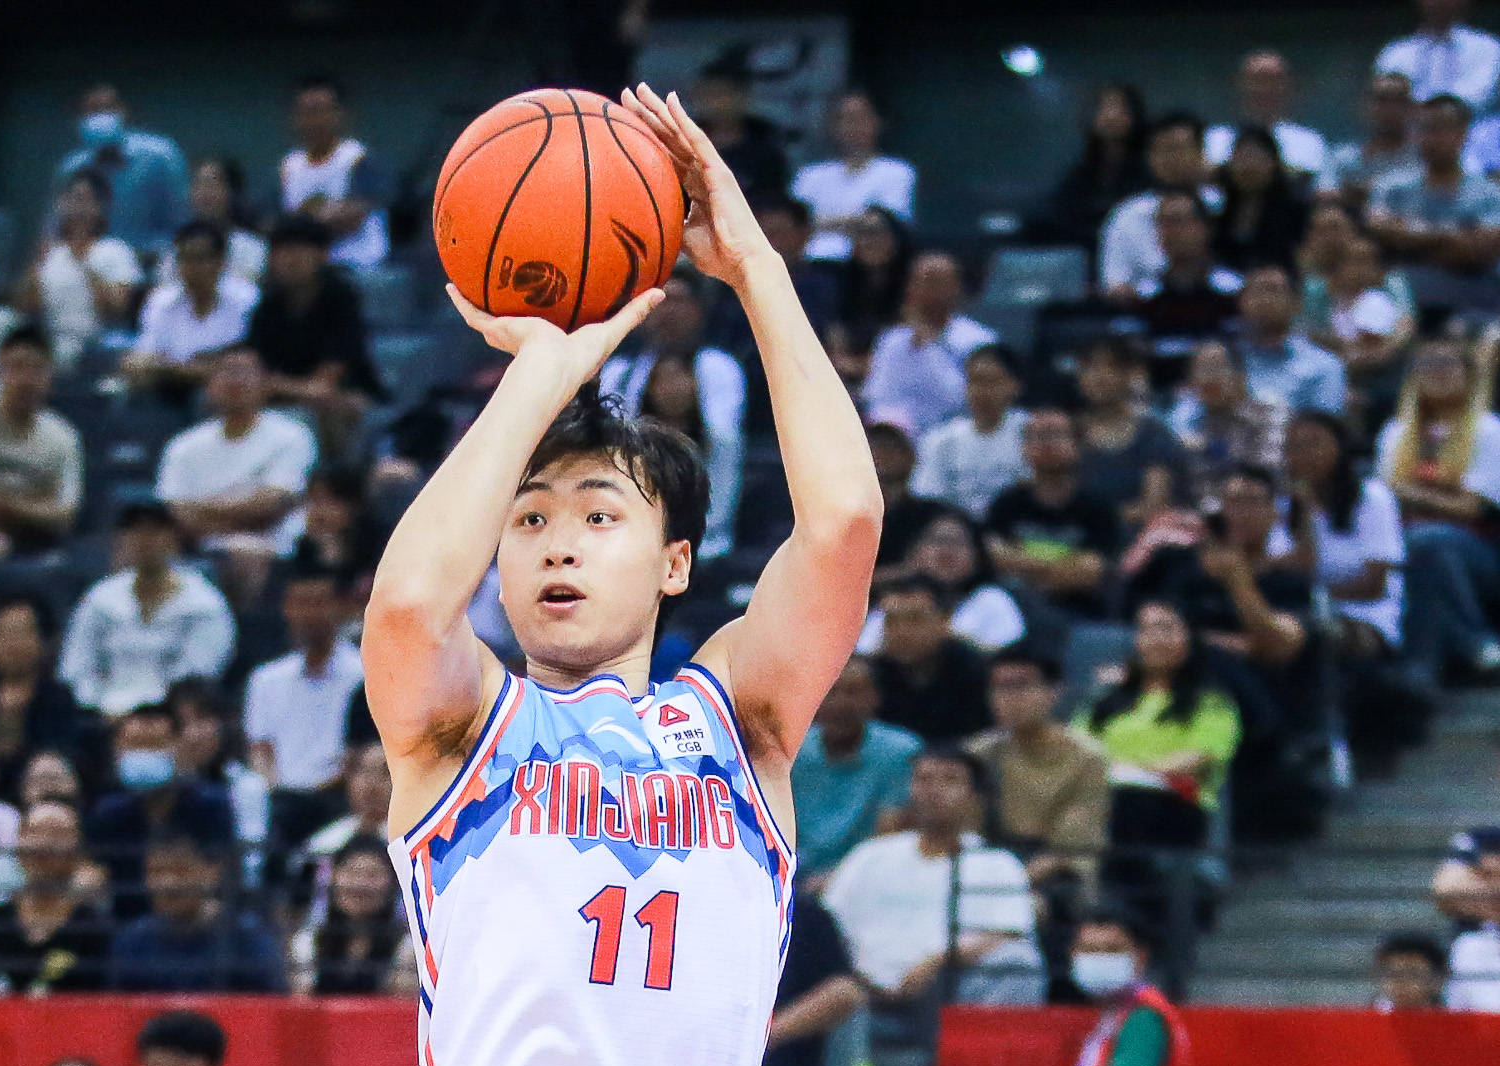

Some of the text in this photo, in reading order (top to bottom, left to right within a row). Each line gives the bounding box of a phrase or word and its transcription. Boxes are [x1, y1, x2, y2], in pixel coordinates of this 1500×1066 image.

[677, 741, 702, 753] CGB
[509, 760, 736, 850] XINJIANG
[578, 885, 679, 991] 11
